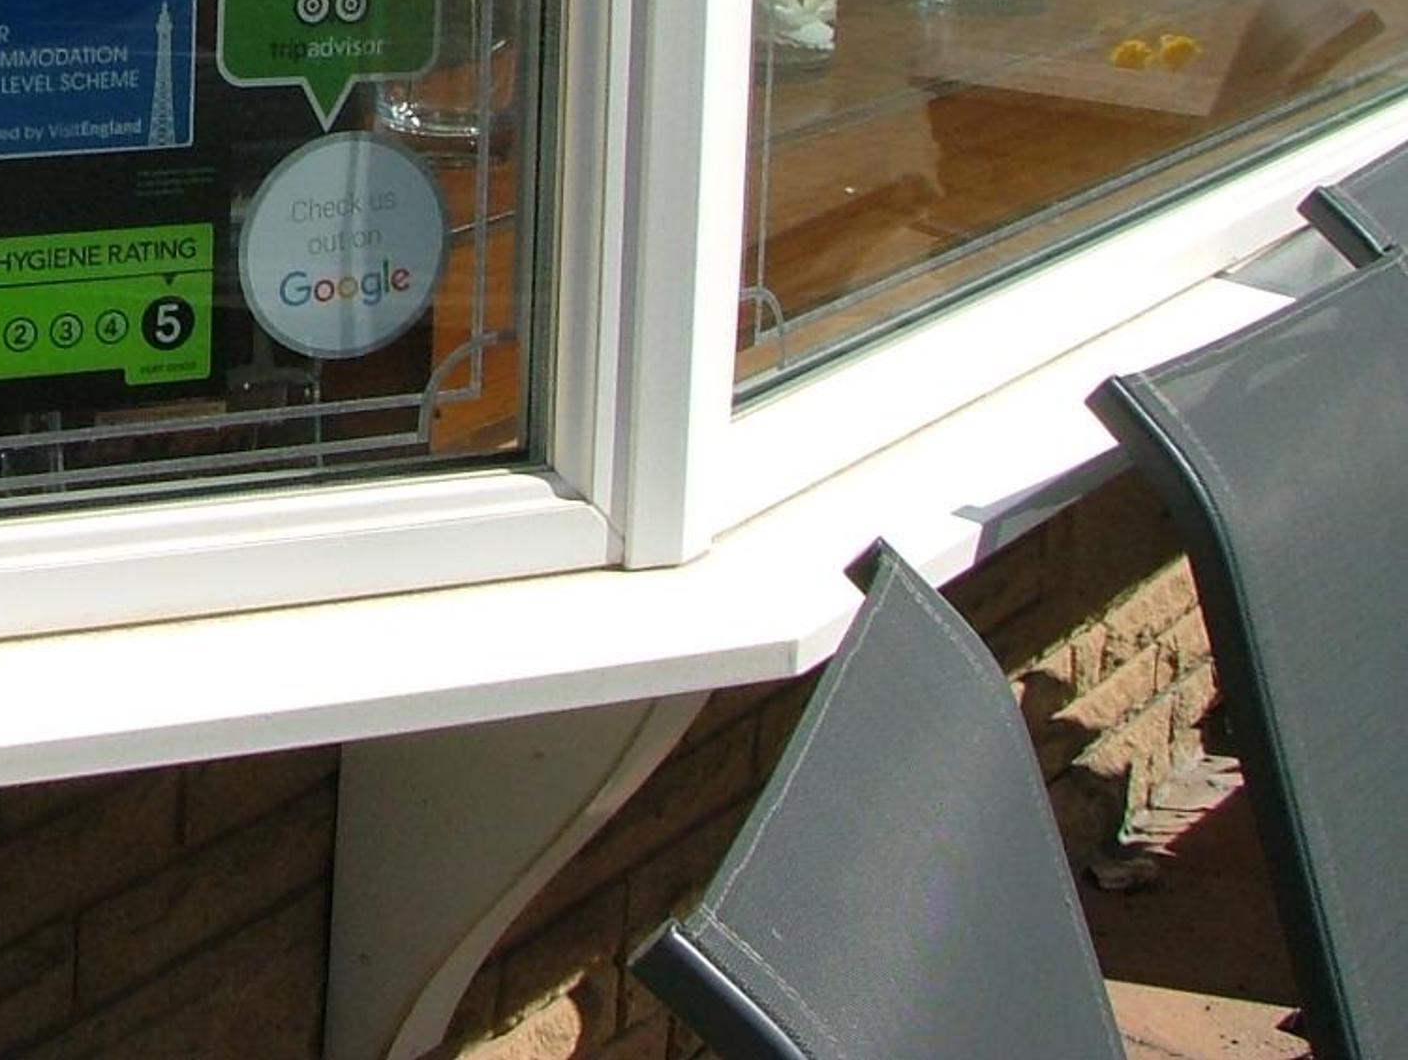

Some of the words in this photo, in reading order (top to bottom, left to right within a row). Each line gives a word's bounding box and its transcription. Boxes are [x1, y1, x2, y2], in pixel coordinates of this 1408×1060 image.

[272, 36, 384, 63] tripadvisor
[1, 74, 53, 95] LEVEL
[61, 69, 140, 92] SCHEME
[24, 123, 43, 143] by
[48, 117, 142, 140] VisitEngland
[292, 194, 362, 223] Check
[370, 191, 396, 211] us
[107, 237, 198, 265] RATING
[308, 230, 345, 255] out
[354, 228, 382, 248] on
[279, 259, 411, 307] Google
[155, 302, 182, 344] 5
